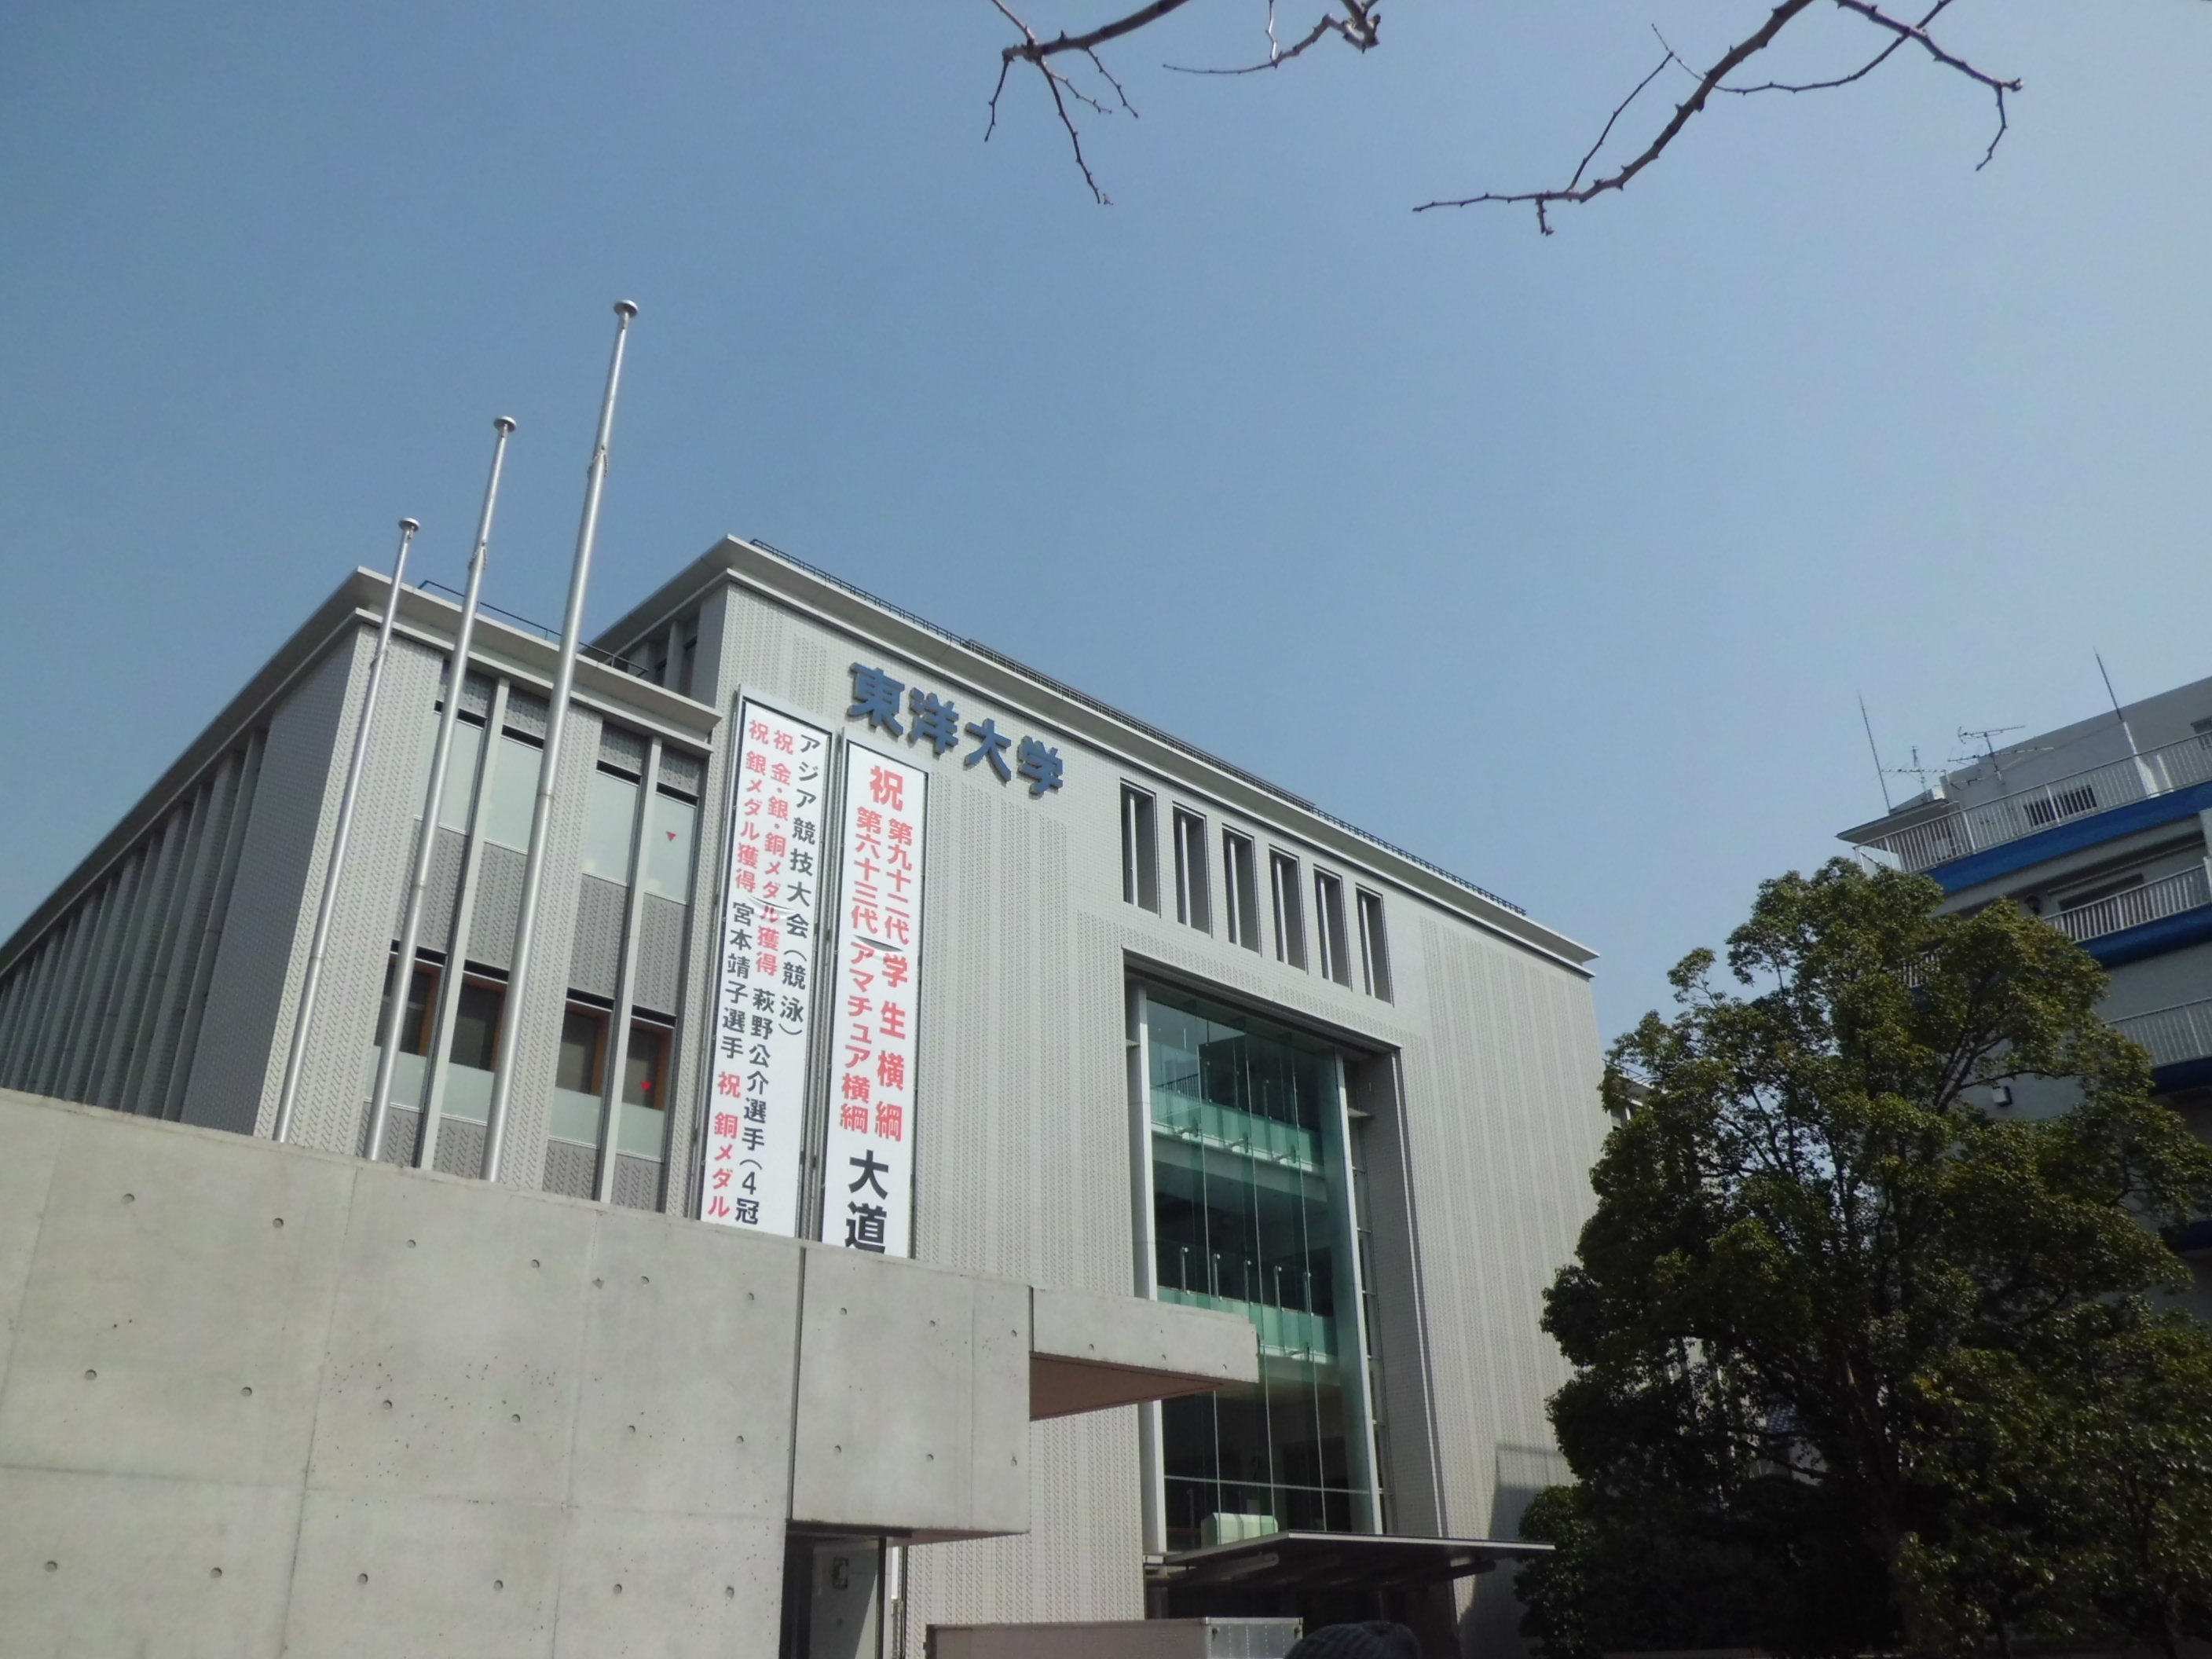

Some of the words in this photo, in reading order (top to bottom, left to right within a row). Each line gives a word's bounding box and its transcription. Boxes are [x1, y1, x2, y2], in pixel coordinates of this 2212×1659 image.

[847, 662, 1064, 797] 東洋大学
[870, 765, 904, 811] 祝
[844, 1149, 889, 1254] 大道
